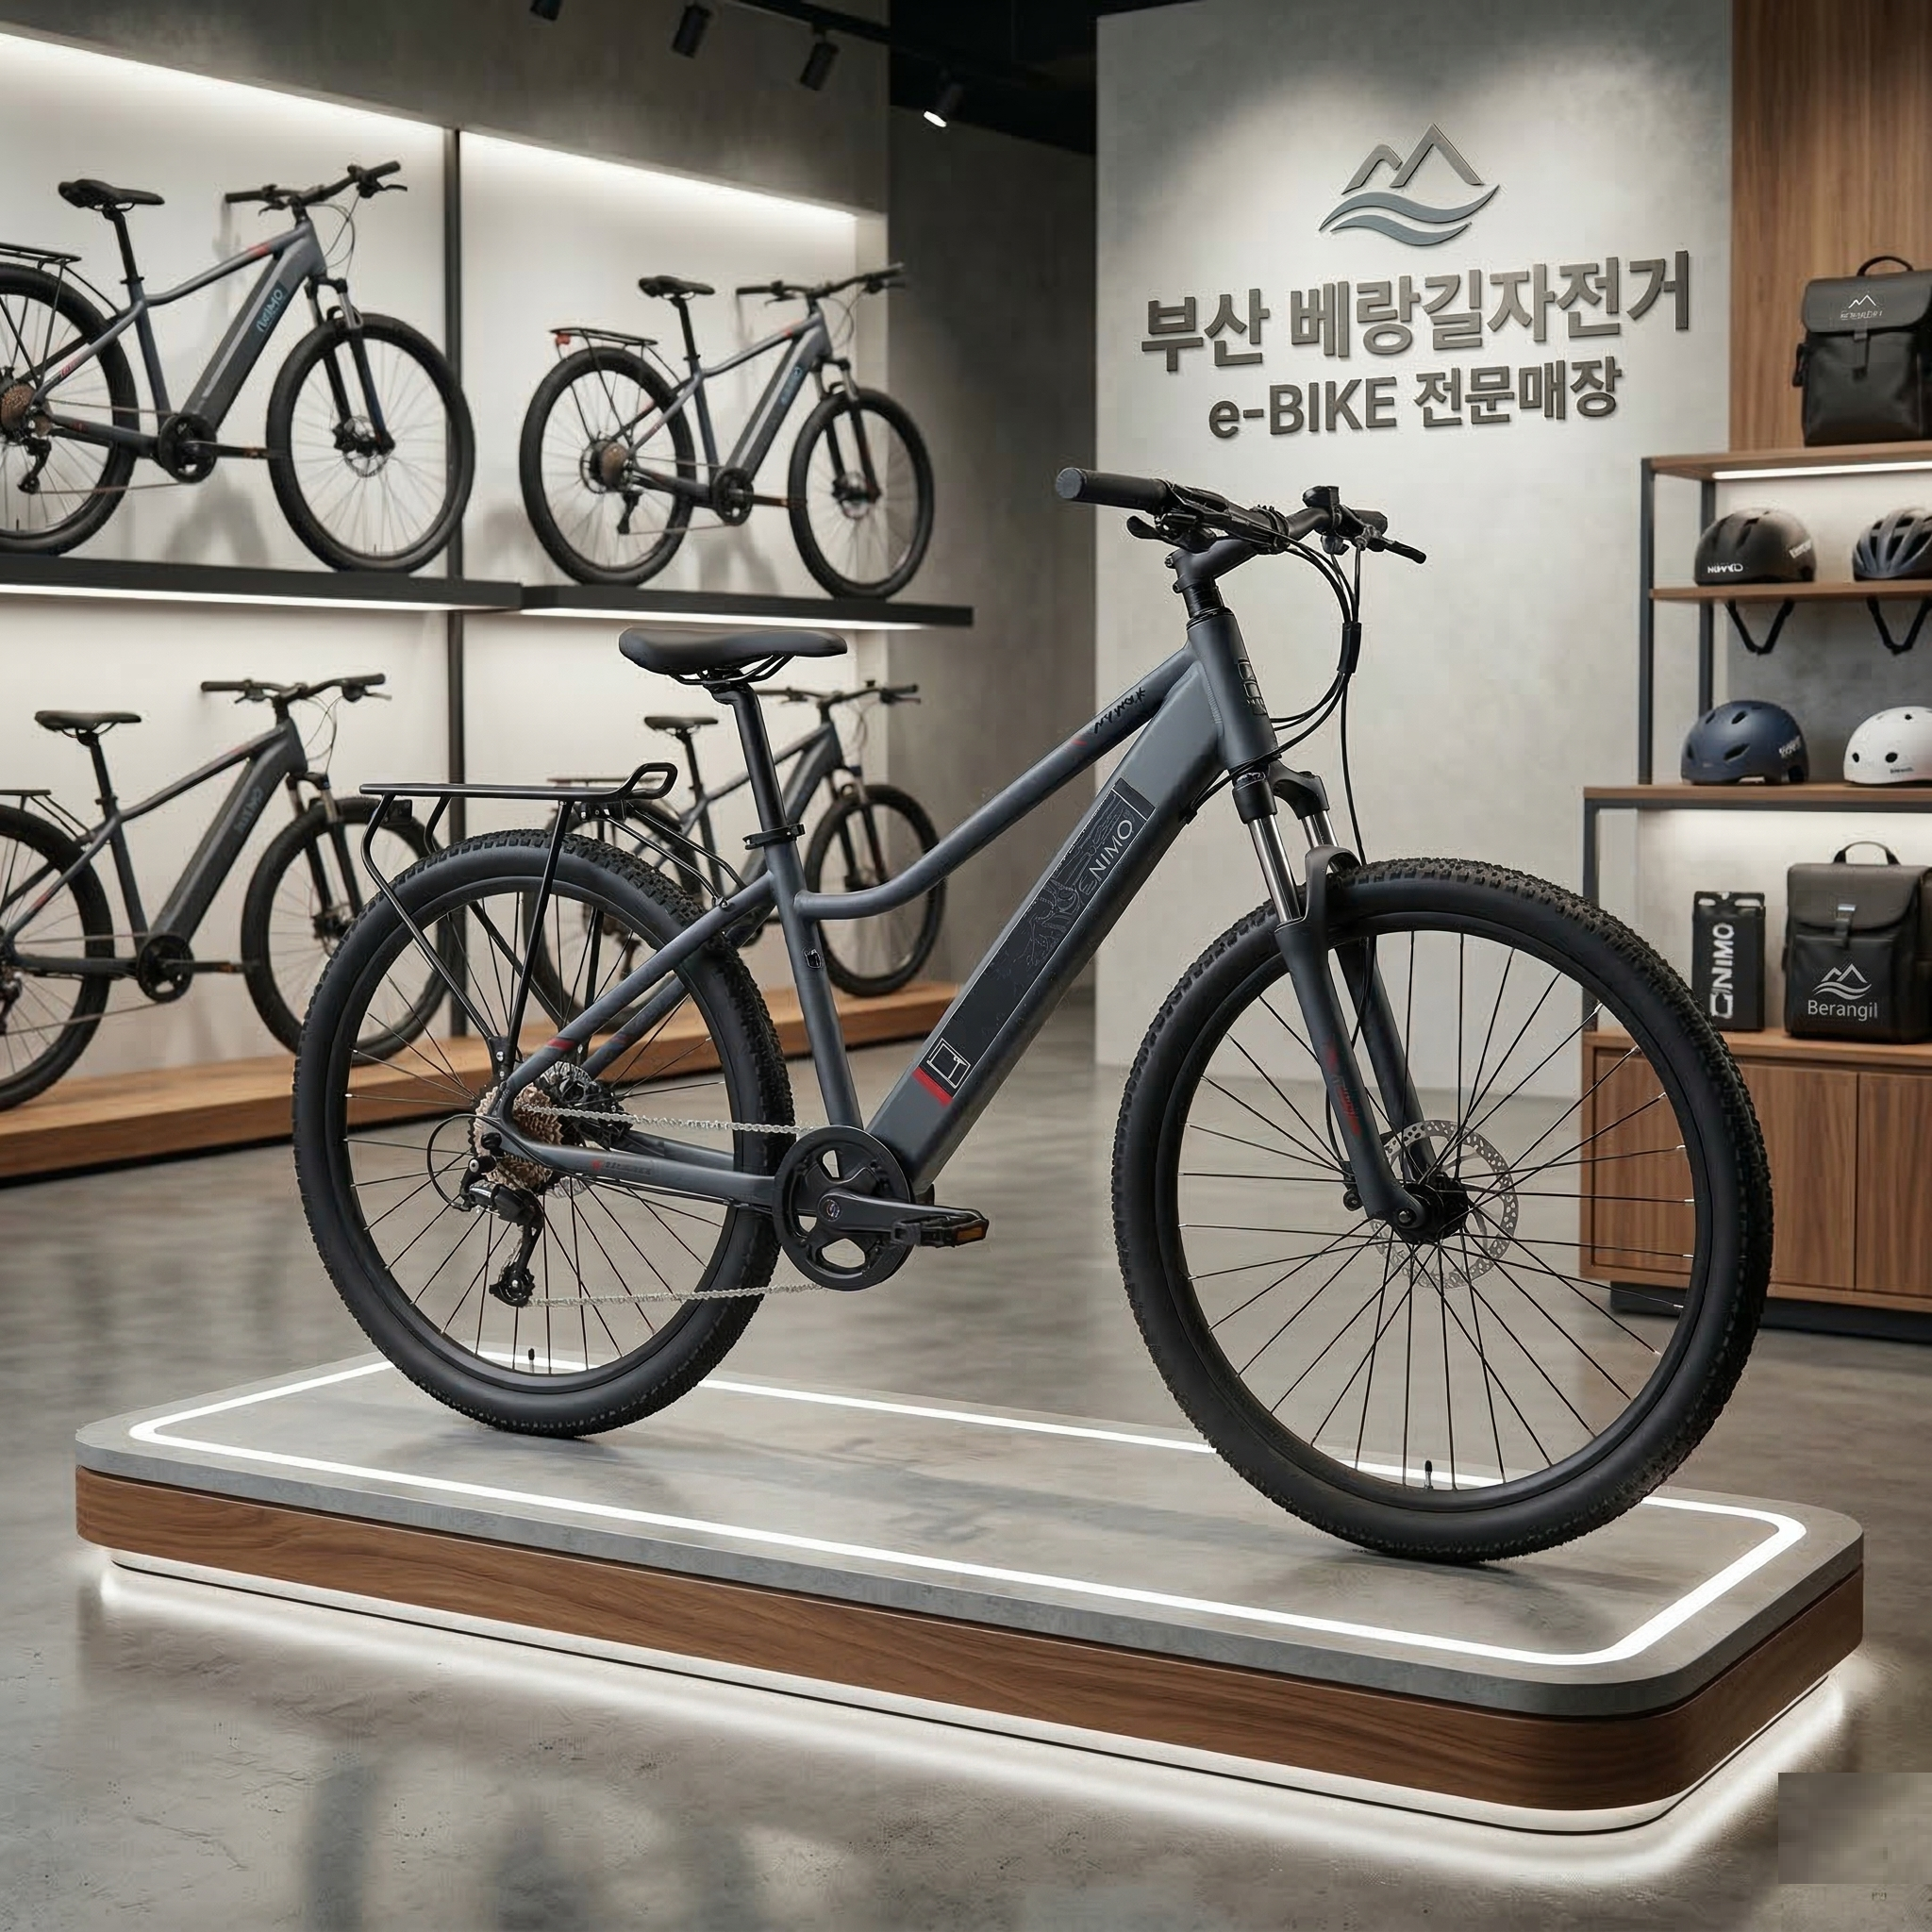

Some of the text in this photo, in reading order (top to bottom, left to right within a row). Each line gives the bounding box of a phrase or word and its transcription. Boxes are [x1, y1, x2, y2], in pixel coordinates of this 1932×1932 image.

[1141, 250, 1690, 372] 부산 베랑길자전거
[1208, 356, 1623, 439] e-BIKE 전문매장
[1807, 999, 1878, 1023] Berangil
